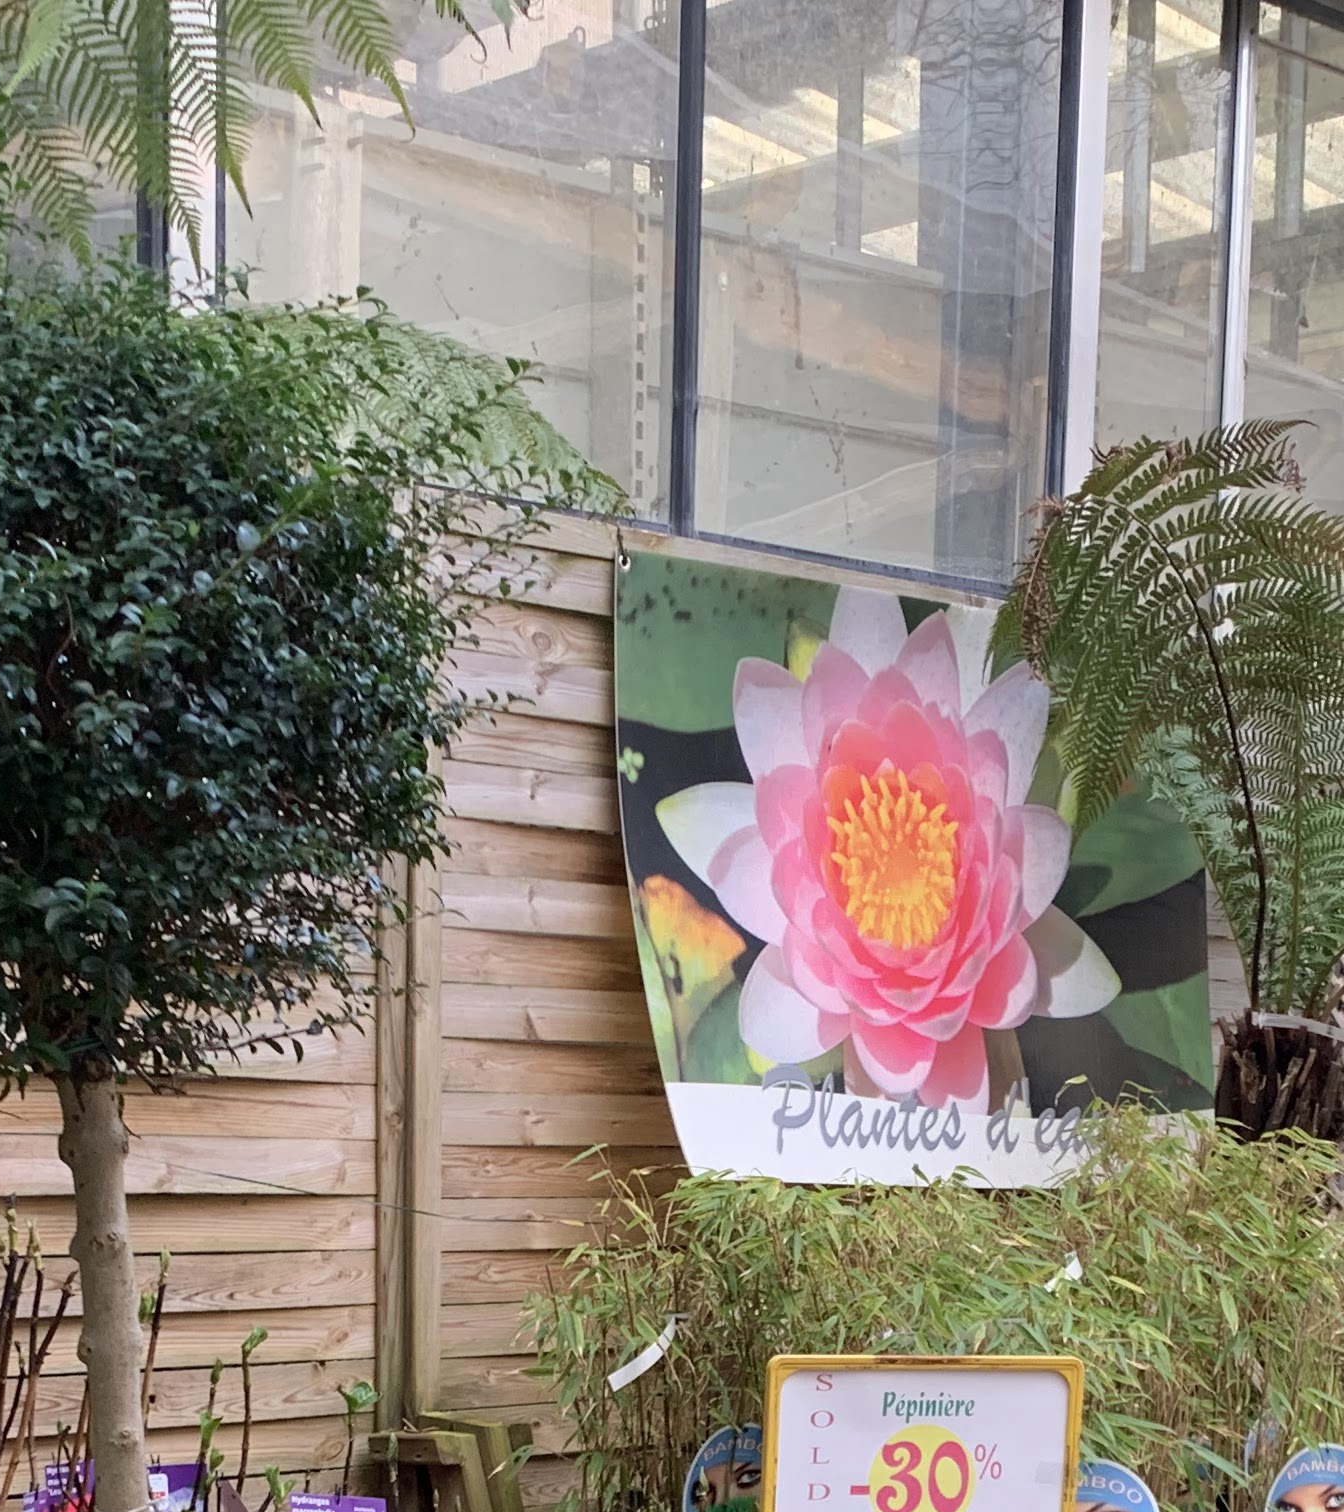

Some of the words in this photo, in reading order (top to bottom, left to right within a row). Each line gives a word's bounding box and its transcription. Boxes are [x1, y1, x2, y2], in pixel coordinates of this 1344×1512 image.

[762, 1063, 965, 1154] Plantes
[986, 1076, 1090, 1153] d'ea
[882, 1391, 975, 1424] Pépinière
